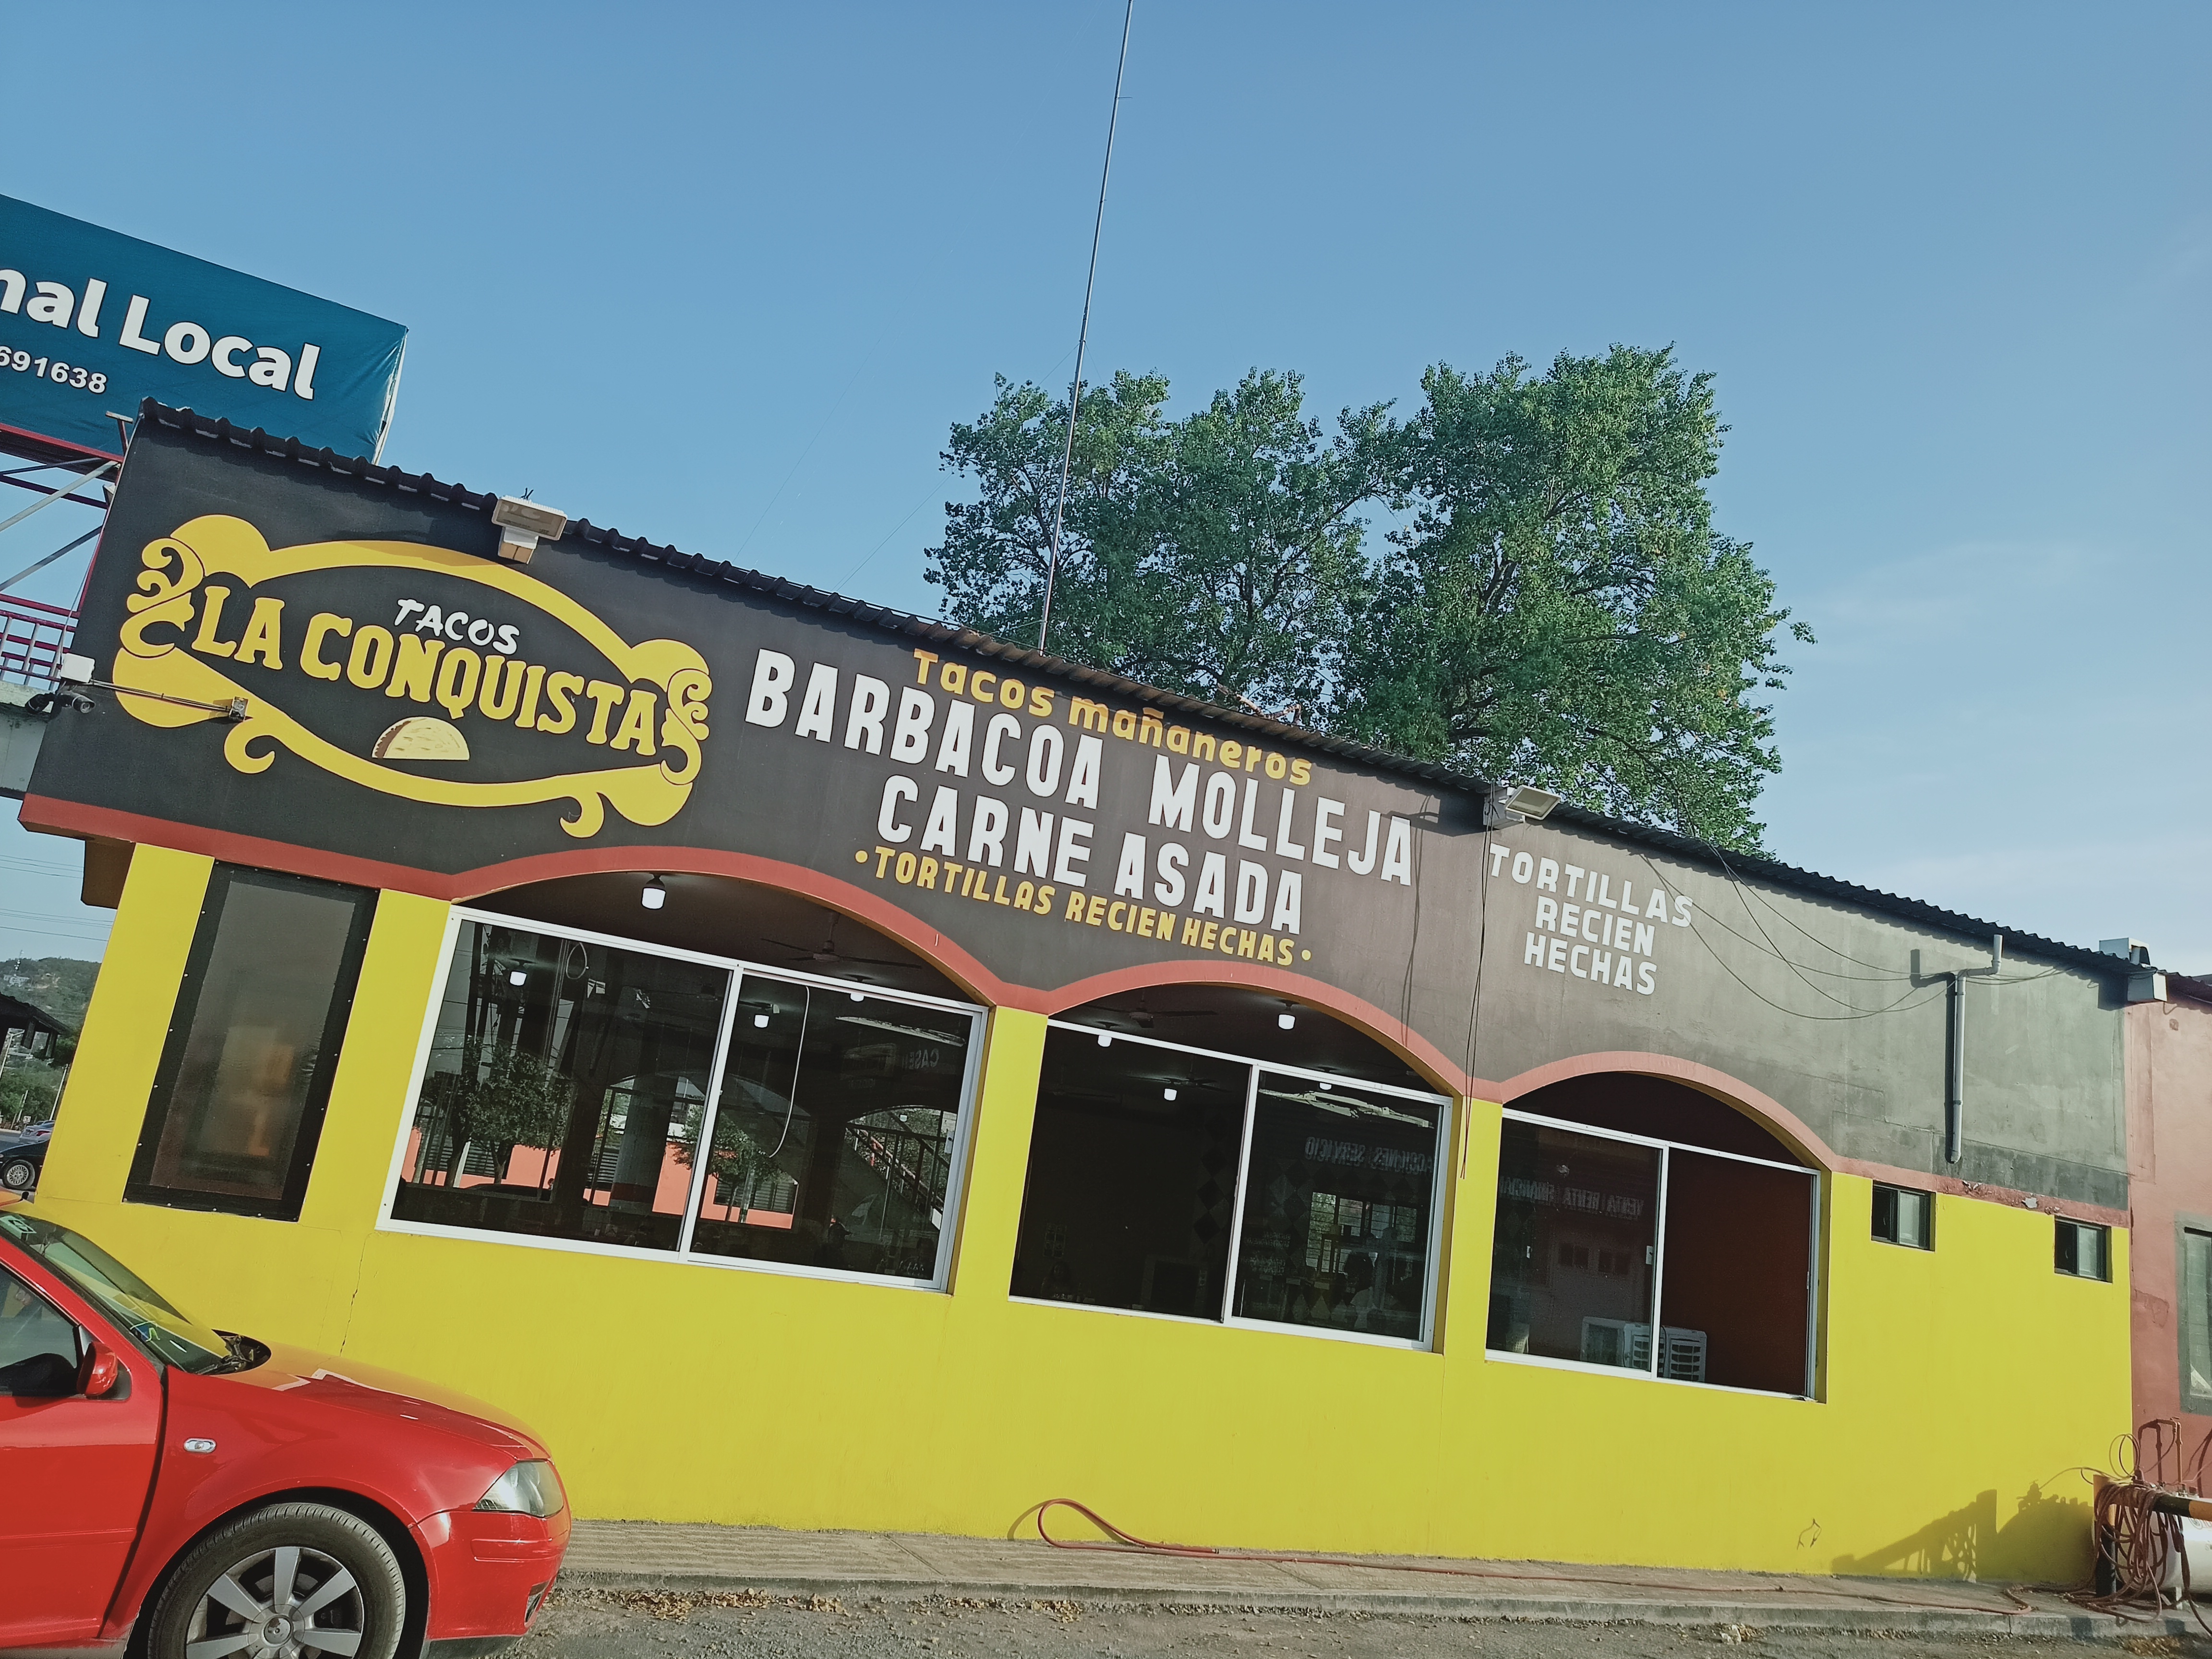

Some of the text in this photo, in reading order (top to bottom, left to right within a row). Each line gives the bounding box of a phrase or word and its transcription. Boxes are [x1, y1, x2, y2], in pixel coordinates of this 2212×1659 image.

[0, 346, 107, 394] 691638
[119, 295, 321, 400] Local
[192, 586, 658, 757] LA CONQUISTA
[395, 599, 519, 654] TACOS
[745, 648, 1412, 887] BARBACOA MOLLEJA
[914, 648, 1312, 786] Tacos mañaneros
[873, 846, 1295, 967] TORTILLAS RECIEN HECHAS
[877, 775, 1302, 935] CARNE ASADA
[1489, 842, 1694, 928] TORTILLAS
[1523, 931, 1658, 996] HECHAS
[1534, 894, 1656, 958] RECIEN
